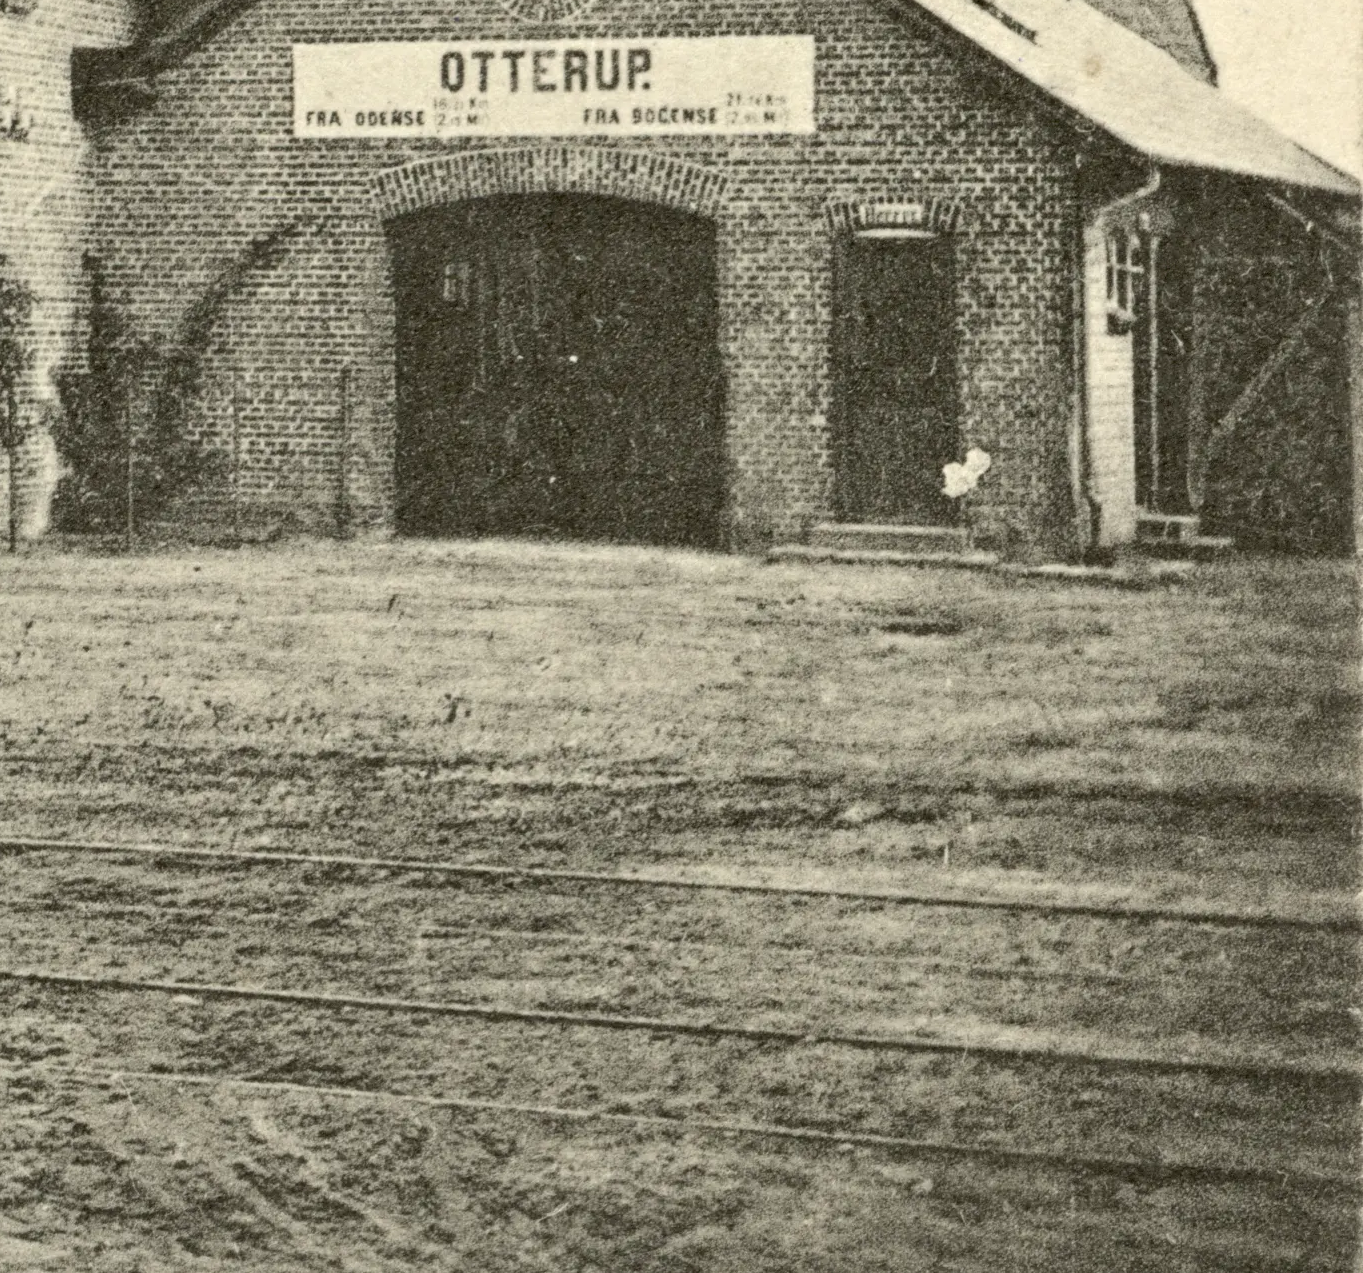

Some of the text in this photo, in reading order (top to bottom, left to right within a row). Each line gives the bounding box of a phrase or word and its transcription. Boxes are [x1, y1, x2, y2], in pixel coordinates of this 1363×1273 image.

[305, 109, 342, 128] FRA
[354, 108, 426, 128] ODENSE
[582, 106, 621, 125] FRA
